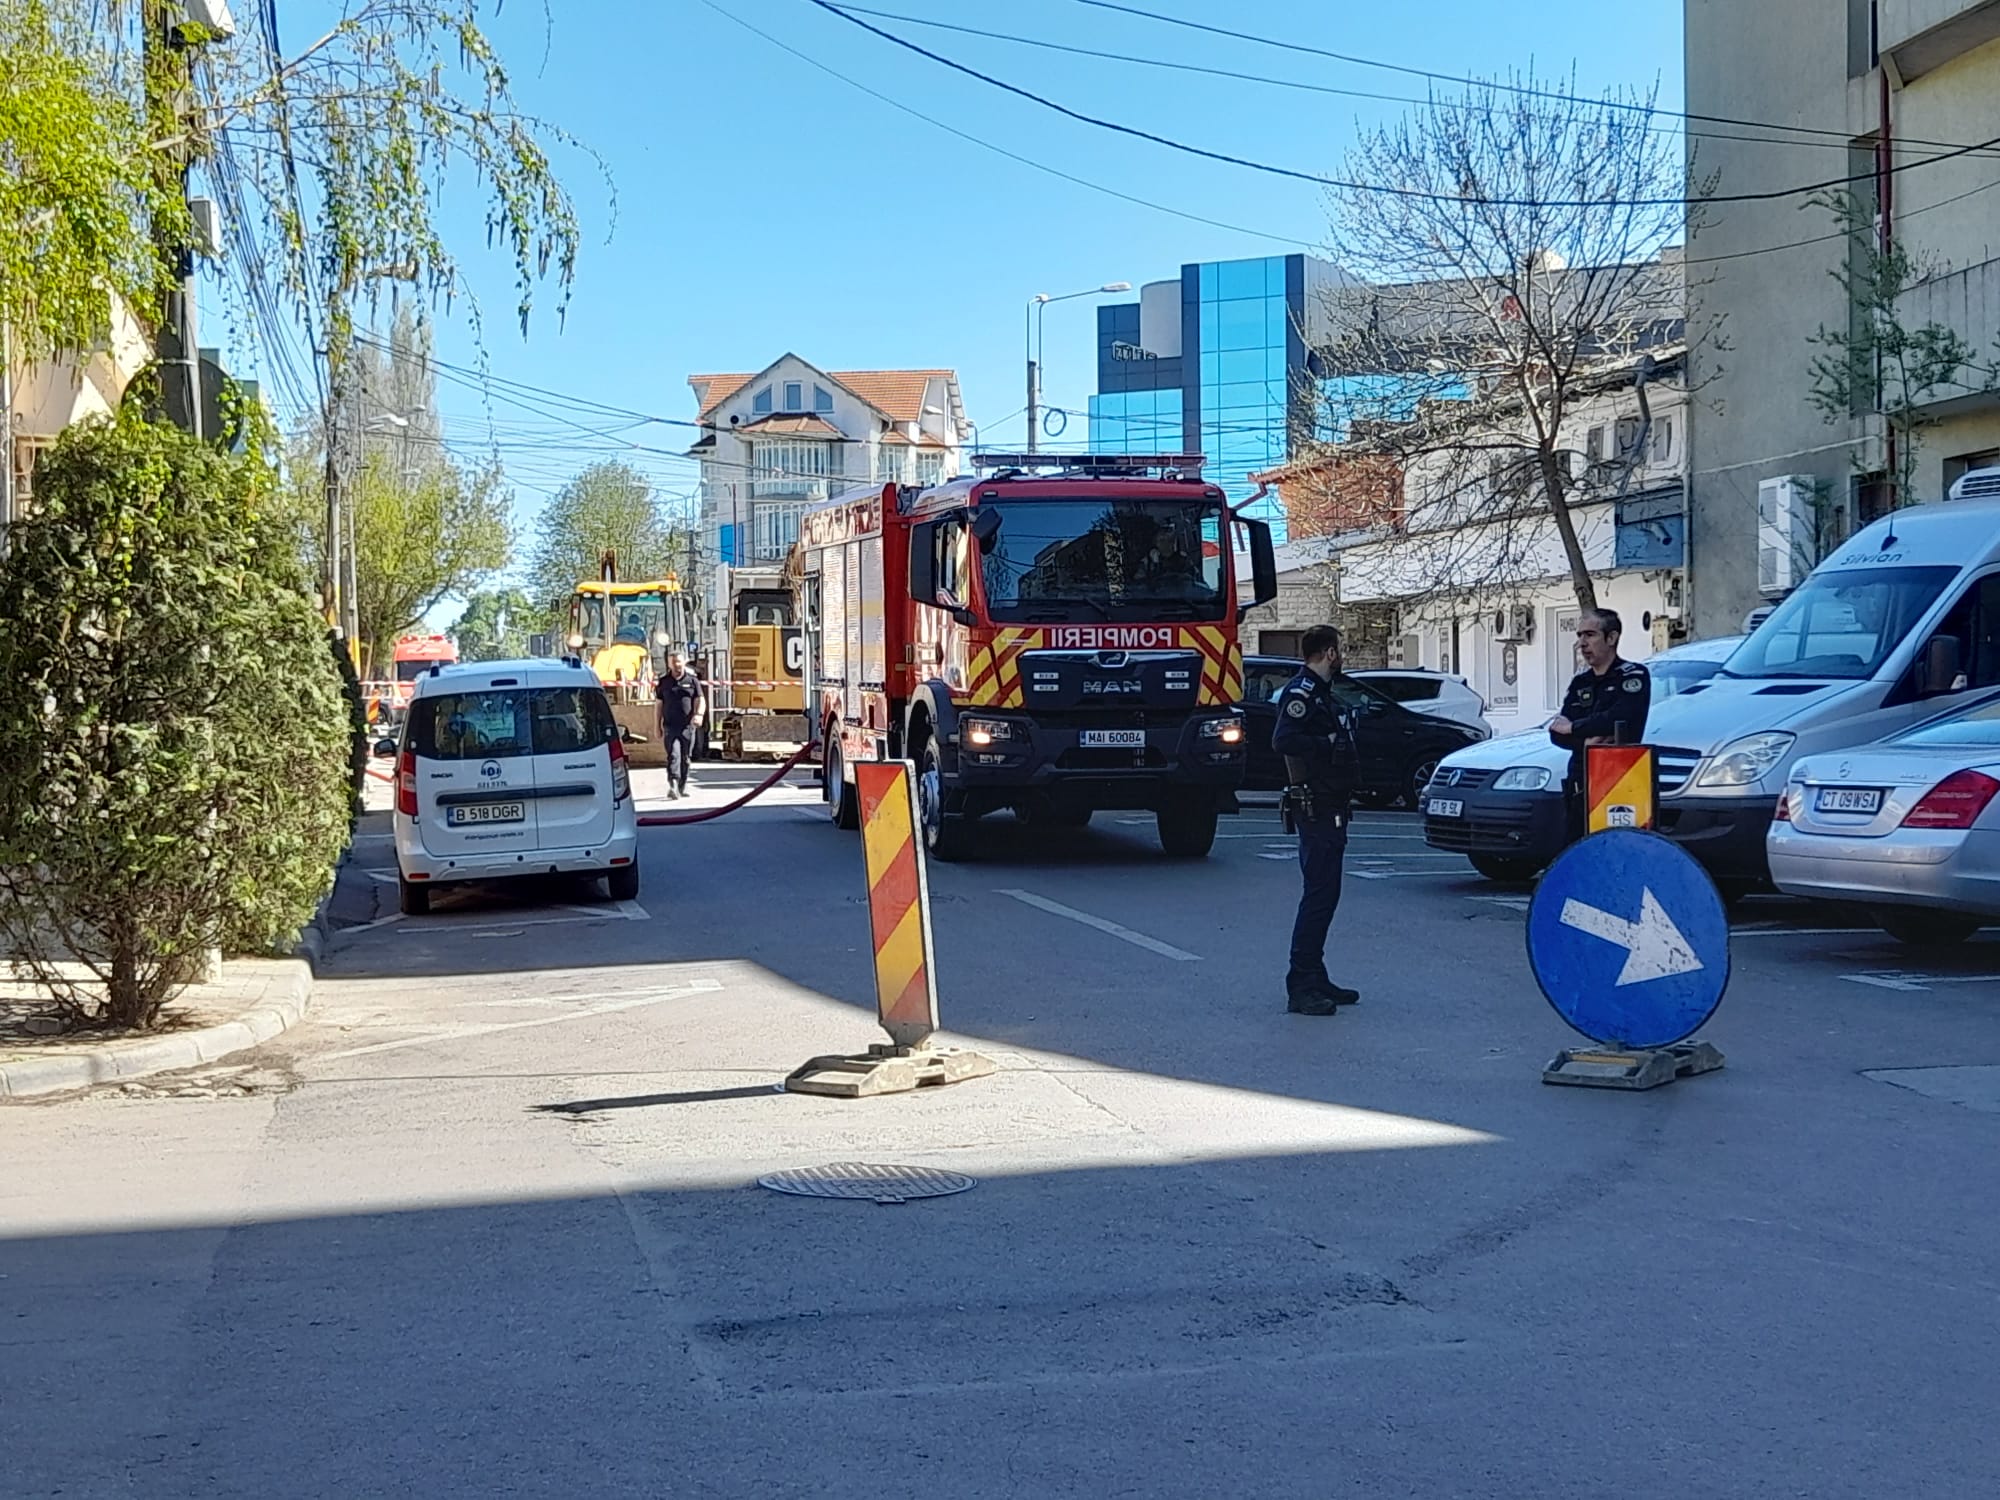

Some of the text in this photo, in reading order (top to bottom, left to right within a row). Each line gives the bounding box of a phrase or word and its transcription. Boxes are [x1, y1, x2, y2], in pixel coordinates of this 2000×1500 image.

[1083, 681, 1142, 693] MAN
[1088, 732, 1142, 745] MAI 60084
[456, 805, 520, 821] B 518 DGR
[1612, 814, 1631, 826] HS
